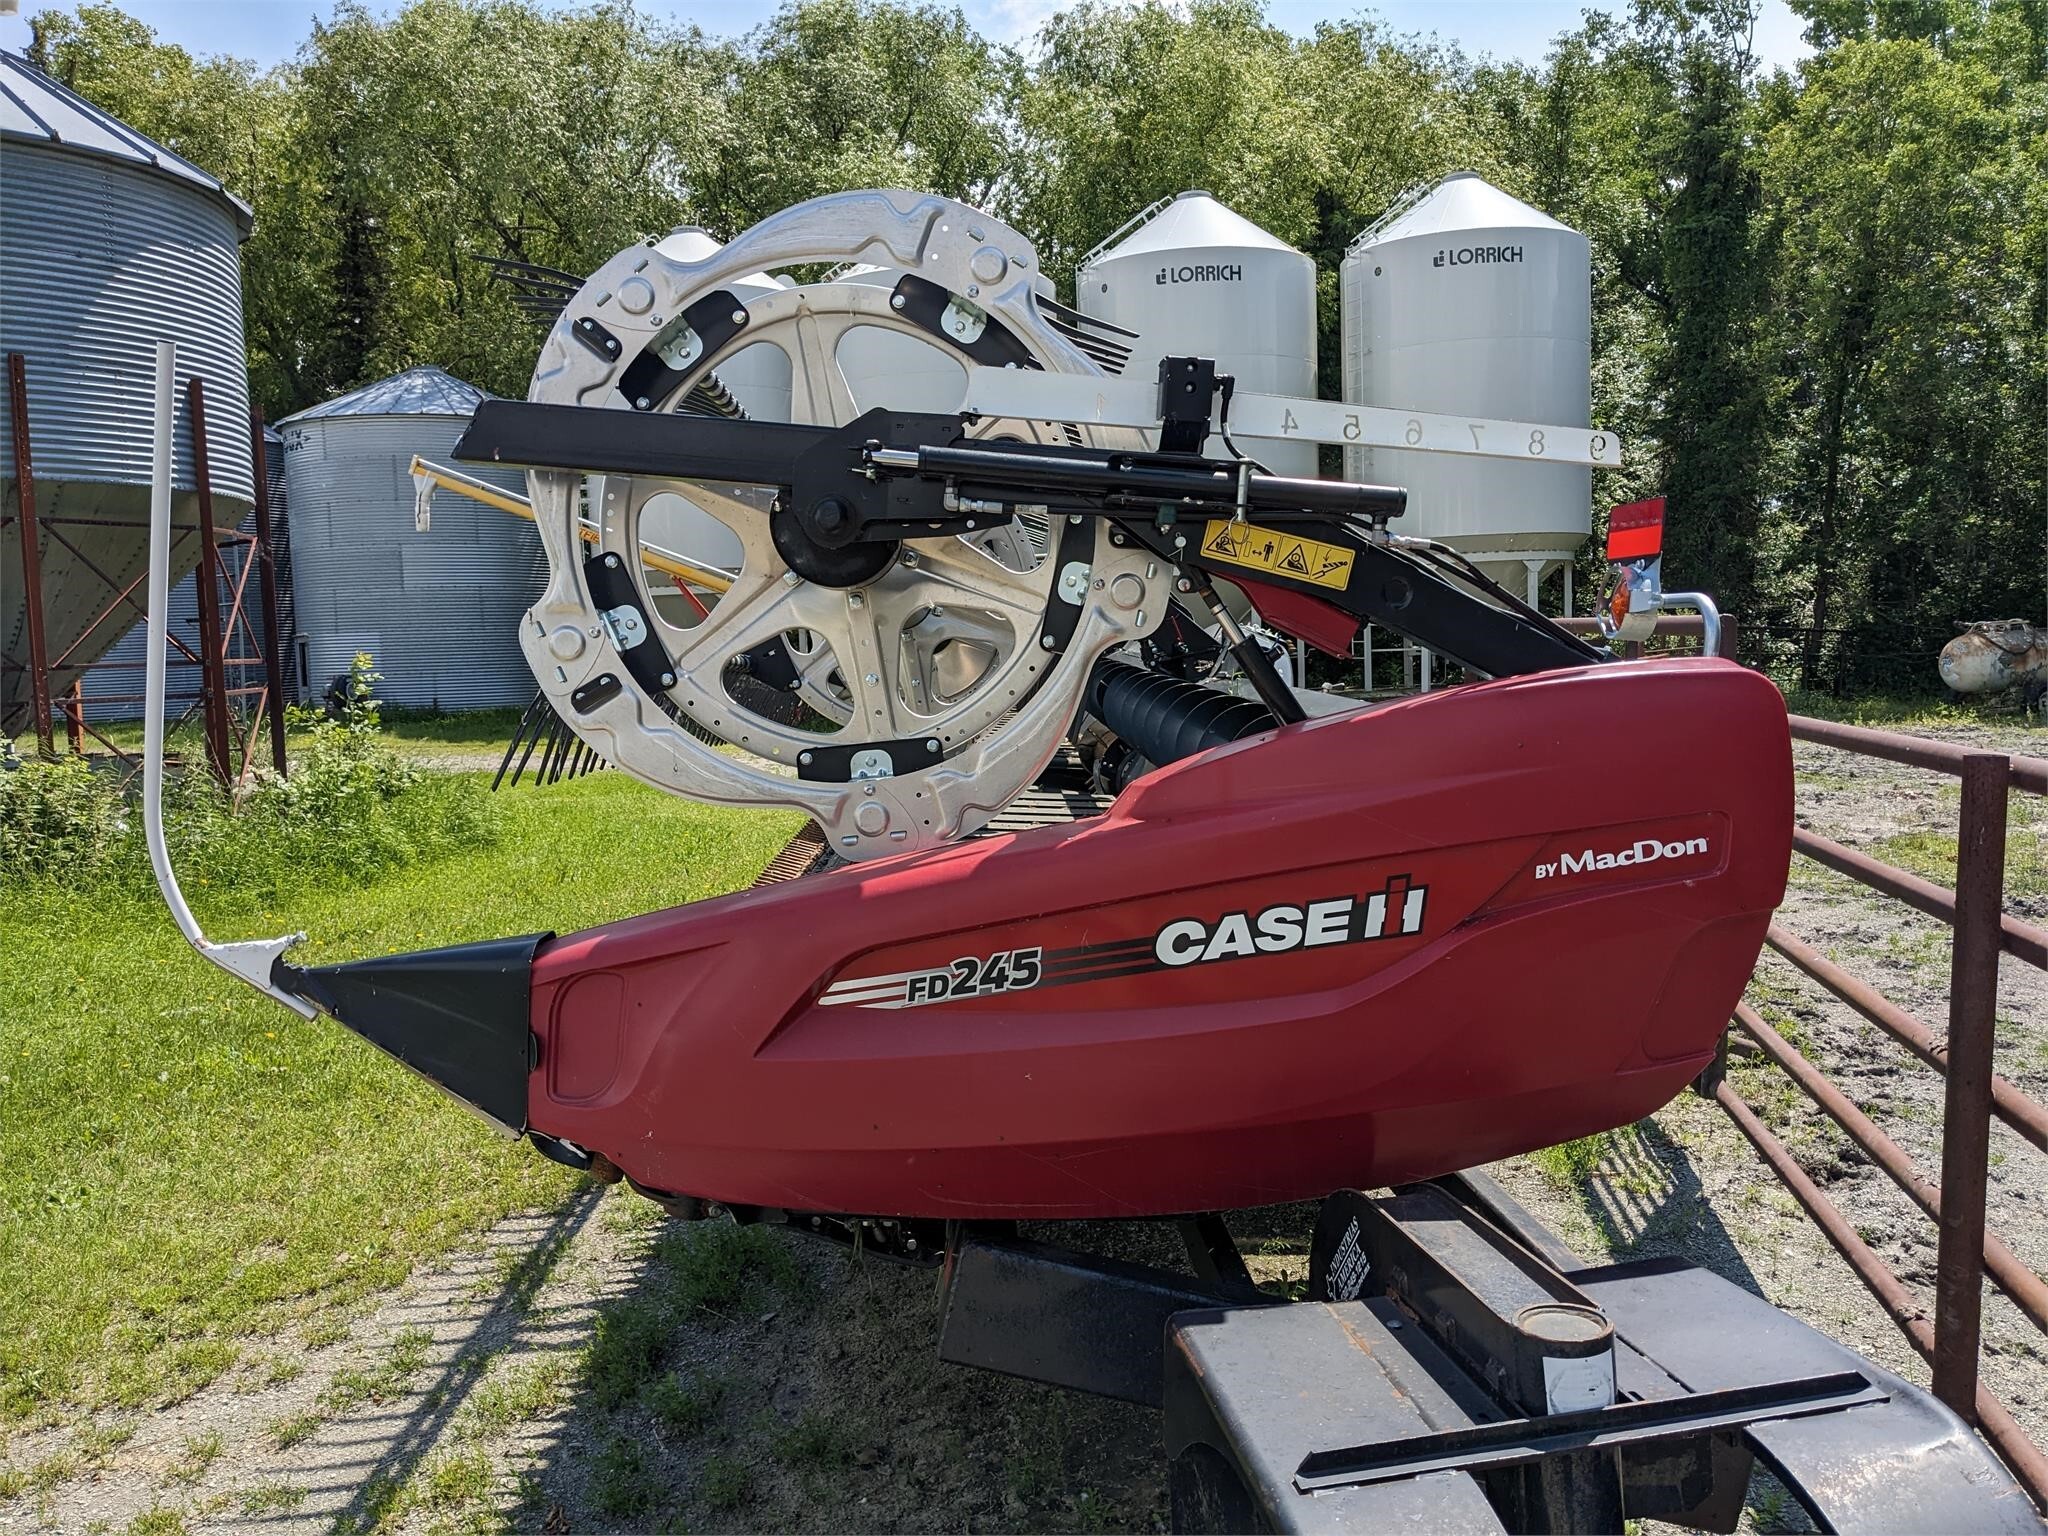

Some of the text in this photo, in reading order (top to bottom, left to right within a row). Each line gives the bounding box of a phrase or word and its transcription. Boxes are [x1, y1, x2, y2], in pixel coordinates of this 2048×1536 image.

[1170, 265, 1242, 283] LORRICH
[1449, 246, 1523, 265] LORRICH
[1535, 837, 1709, 880] BY MacDon
[1154, 895, 1356, 968] CASE
[905, 945, 1044, 1004] FD245
[1329, 1215, 1359, 1278] INDUSTRIAS
[1338, 1242, 1362, 1293] AMERICA
